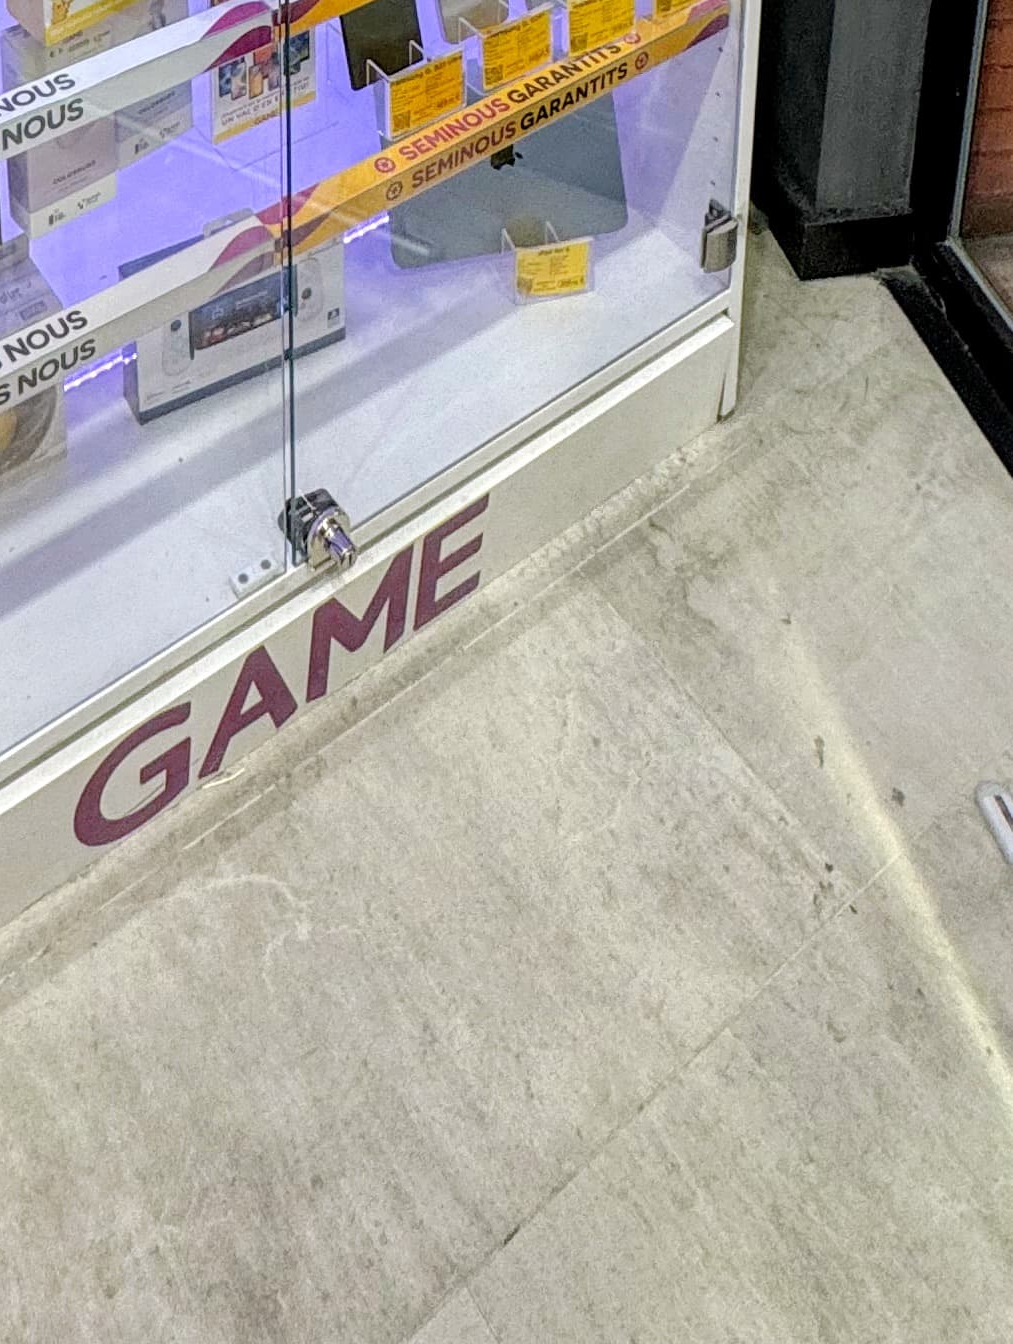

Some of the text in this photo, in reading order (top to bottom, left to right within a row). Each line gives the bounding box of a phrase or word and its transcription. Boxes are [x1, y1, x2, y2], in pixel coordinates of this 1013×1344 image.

[2, 97, 85, 152] NOUS
[399, 99, 510, 162] SEMINOUS
[507, 42, 621, 105] GARANTITS
[412, 124, 516, 189] SEMINOUS
[520, 63, 628, 132] GARANTITS
[3, 309, 89, 364] NOUS
[17, 338, 97, 397] NOUS
[73, 493, 489, 848] GAME
